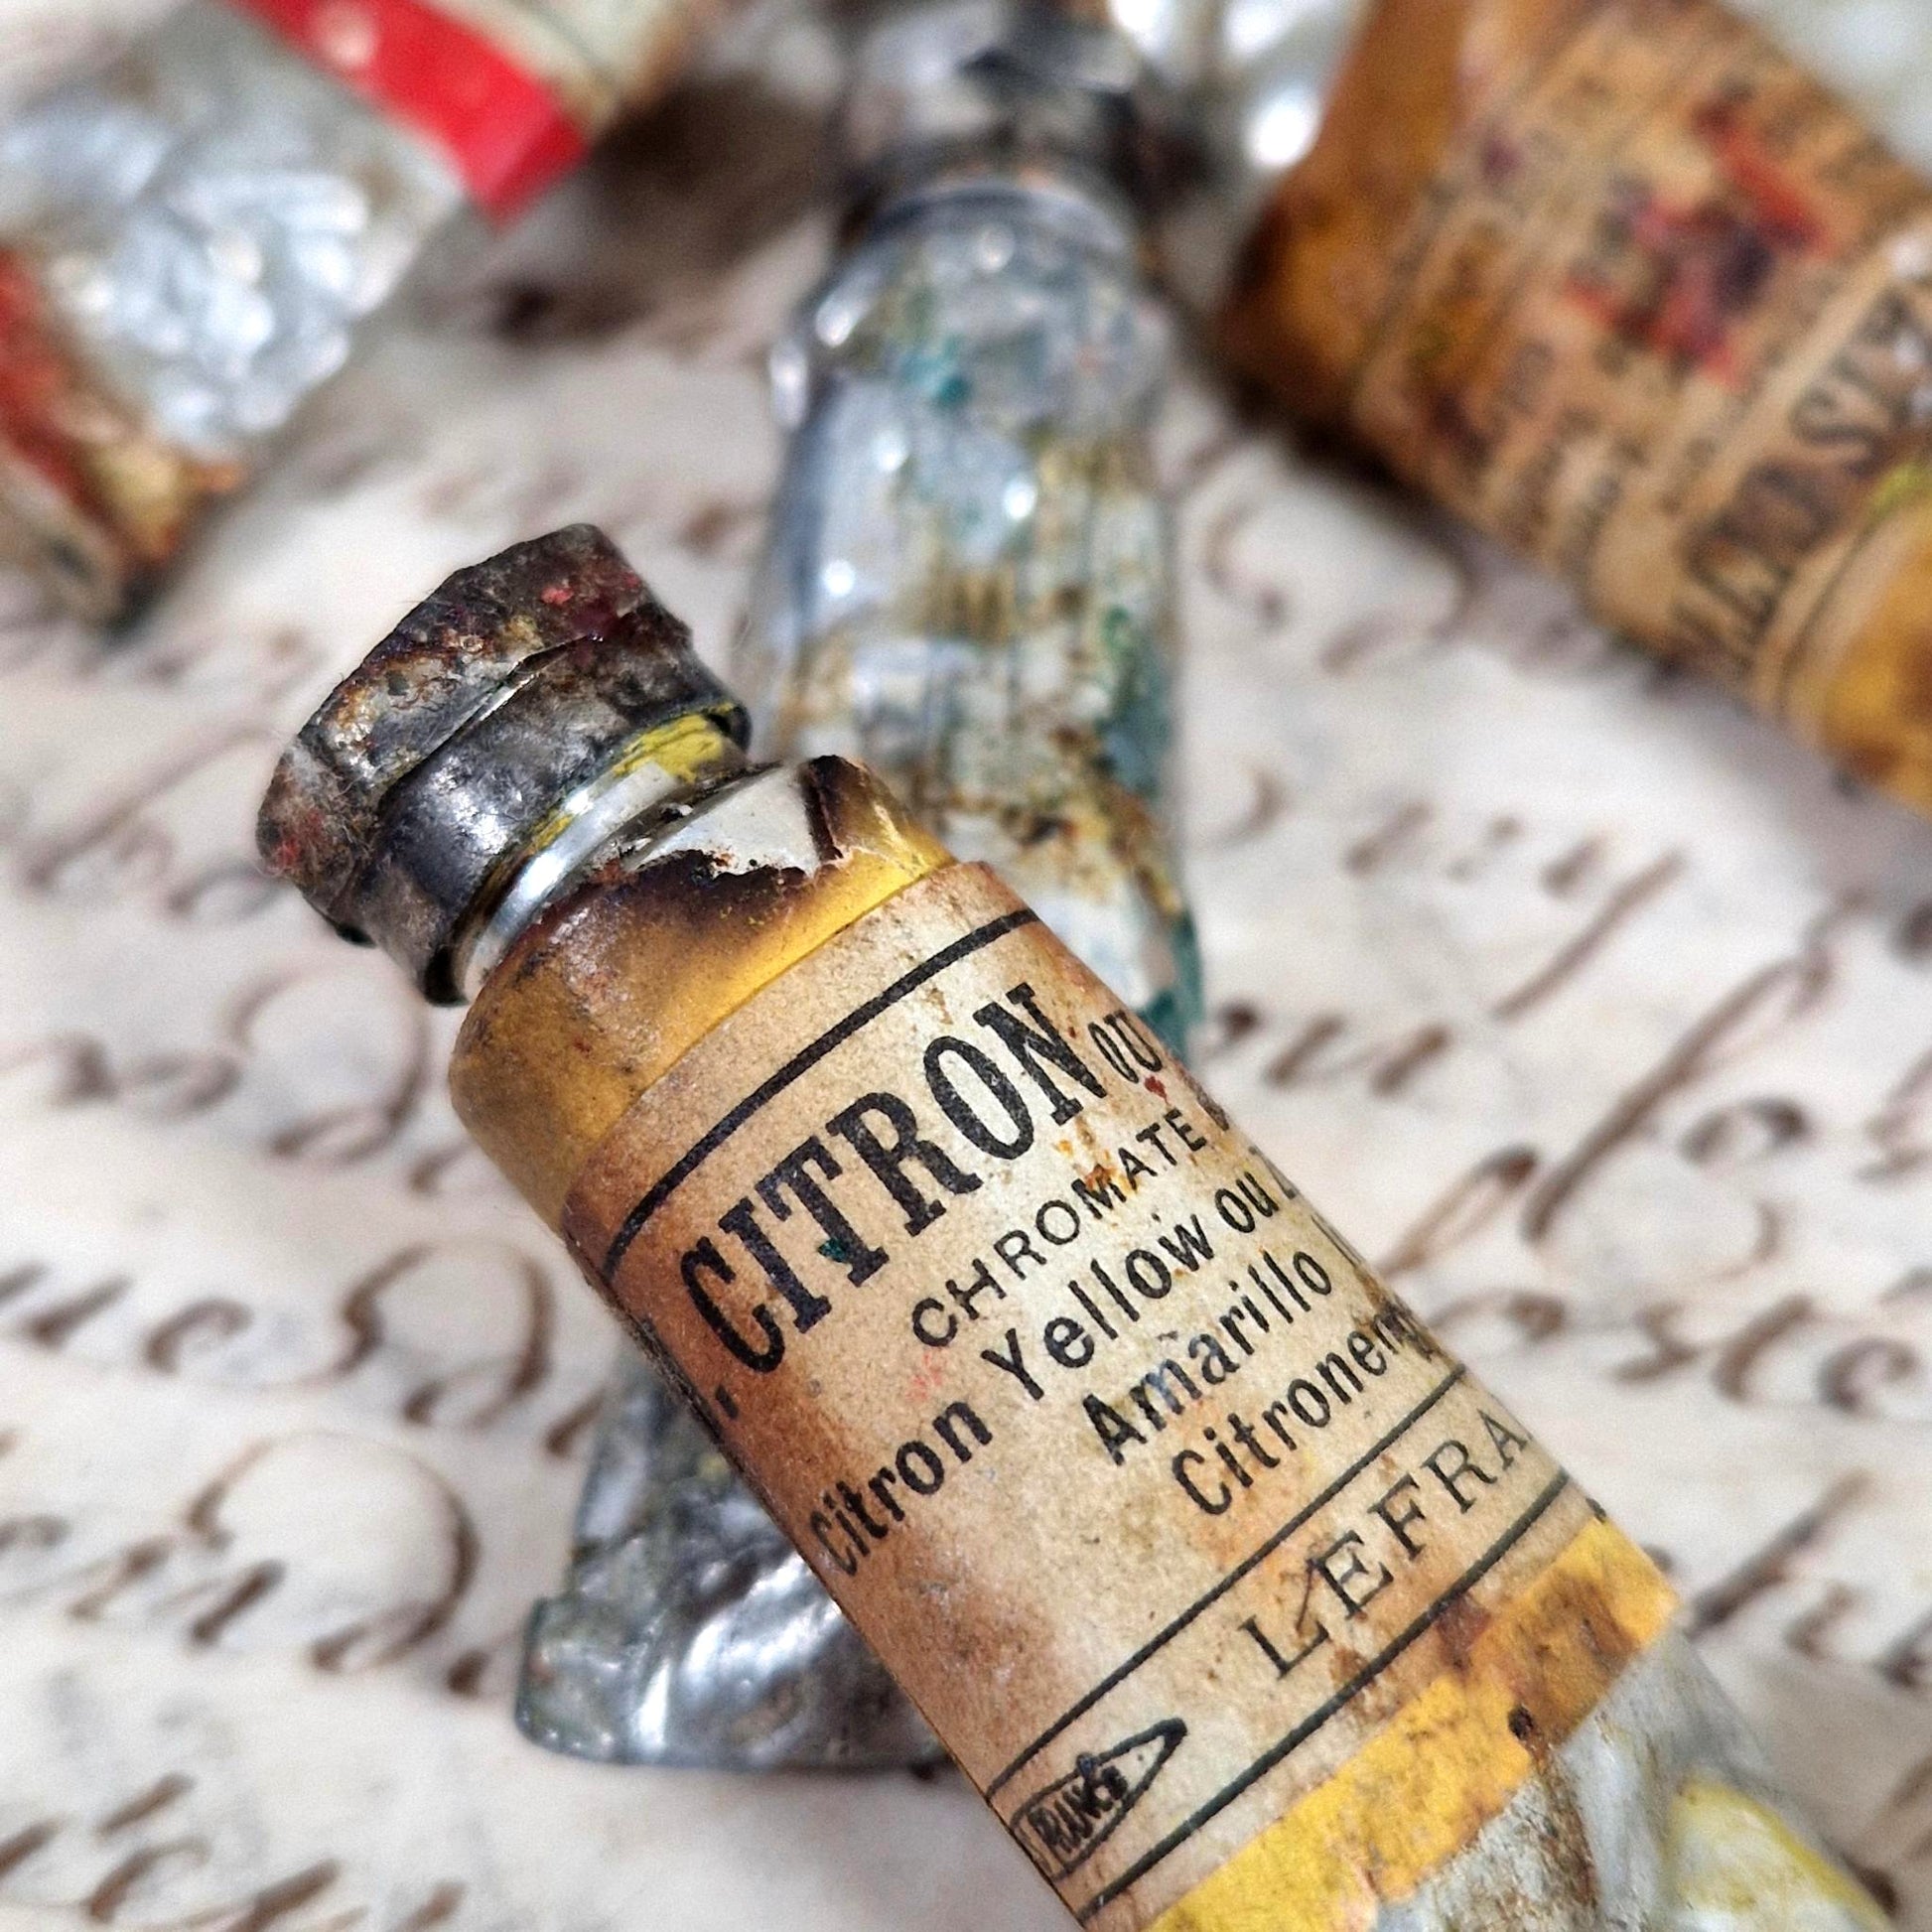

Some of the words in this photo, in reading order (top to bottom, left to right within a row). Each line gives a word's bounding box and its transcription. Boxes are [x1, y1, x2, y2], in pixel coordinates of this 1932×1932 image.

[680, 982, 1109, 1372] CITRON
[1088, 1010, 1164, 1083] OU
[911, 1109, 1207, 1347] CHROMATE
[808, 1400, 993, 1576] Citron
[981, 1213, 1214, 1401] Yellow
[1082, 1250, 1332, 1466] Amarillo
